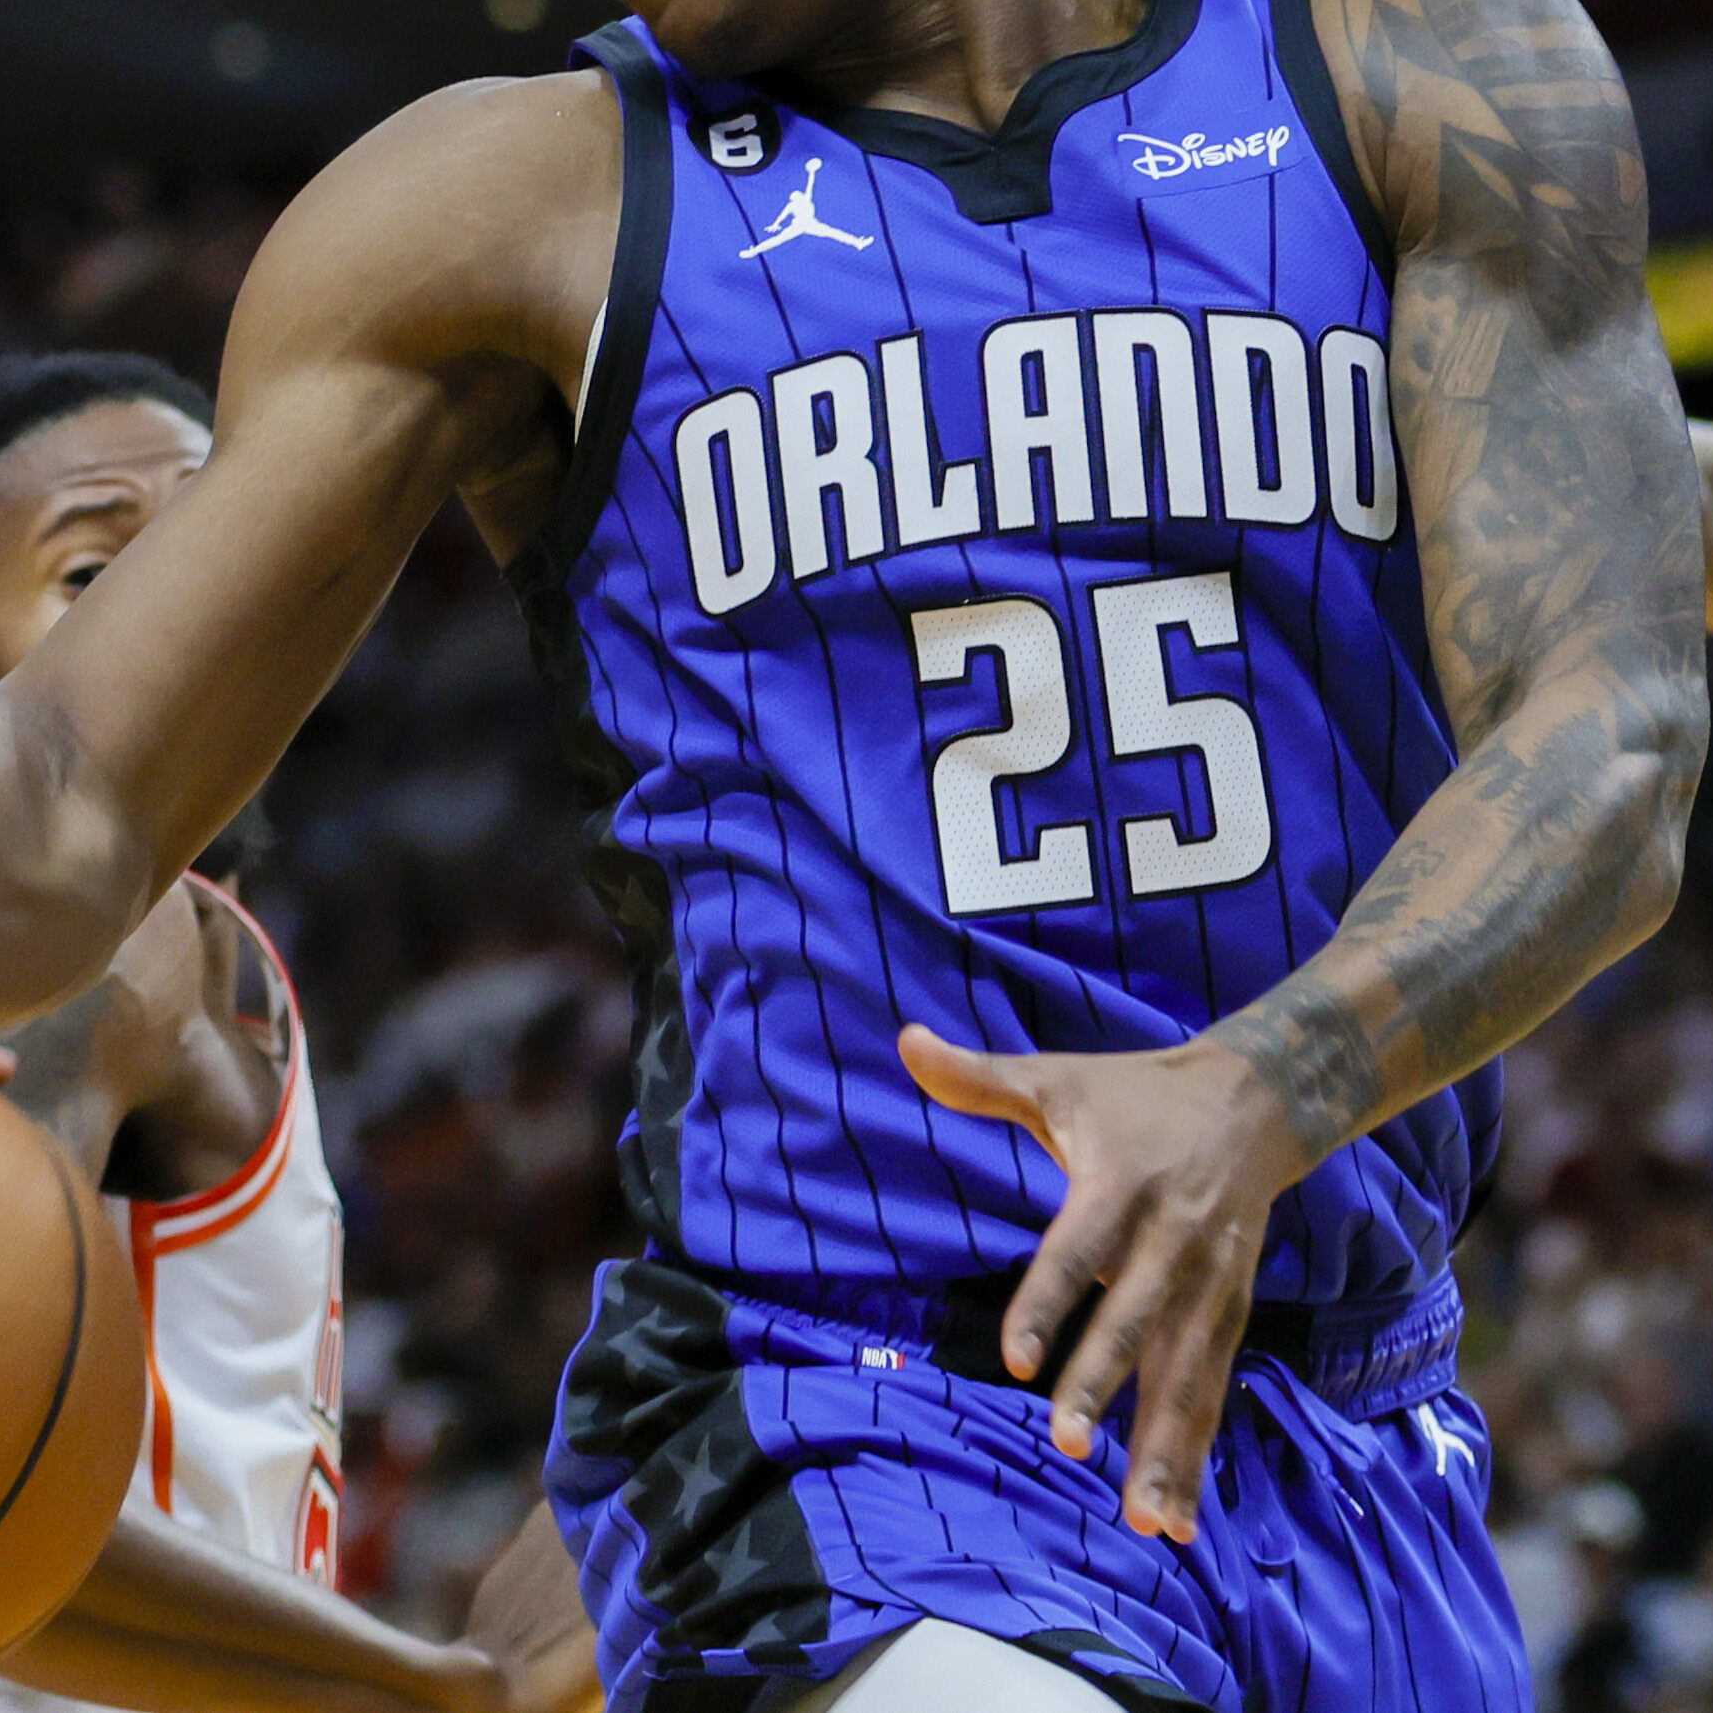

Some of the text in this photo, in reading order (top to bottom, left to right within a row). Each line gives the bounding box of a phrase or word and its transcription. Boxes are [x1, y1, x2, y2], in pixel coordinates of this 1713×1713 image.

[708, 114, 764, 168] 6
[1118, 125, 1290, 180] Disney
[675, 307, 1399, 618] ORLANDO
[909, 570, 1273, 915] 25
[861, 1346, 888, 1369] NBA
